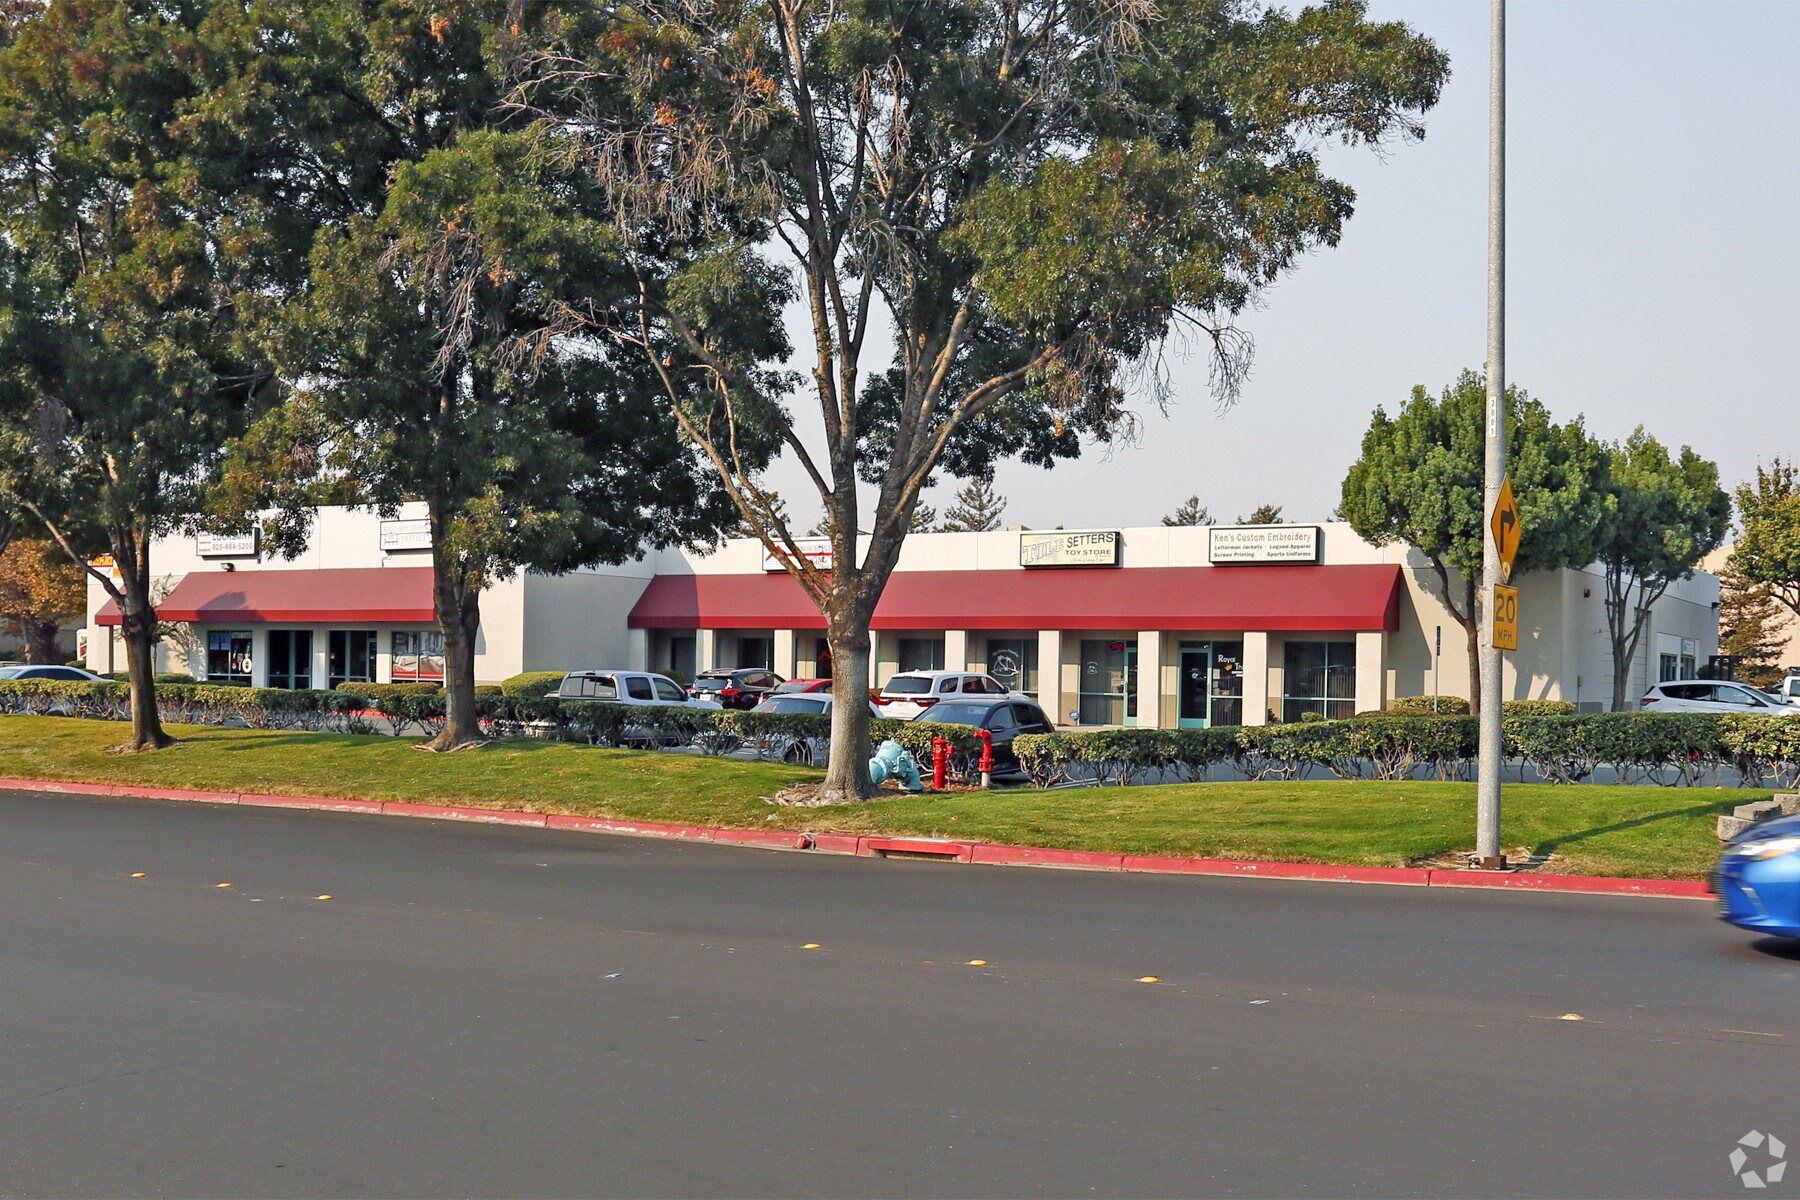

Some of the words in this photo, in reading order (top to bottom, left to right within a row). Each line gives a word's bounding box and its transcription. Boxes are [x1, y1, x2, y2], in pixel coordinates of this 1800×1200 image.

[1214, 533, 1235, 542] Ken's
[1237, 533, 1265, 542] Custom
[1267, 532, 1311, 543] Embroidery
[212, 543, 253, 551] 925-964-5200
[1022, 539, 1065, 564] TILE
[1066, 533, 1114, 549] SETTERS
[1496, 593, 1515, 624] 20
[1497, 629, 1512, 642] MPH
[1218, 654, 1236, 663] Royal
